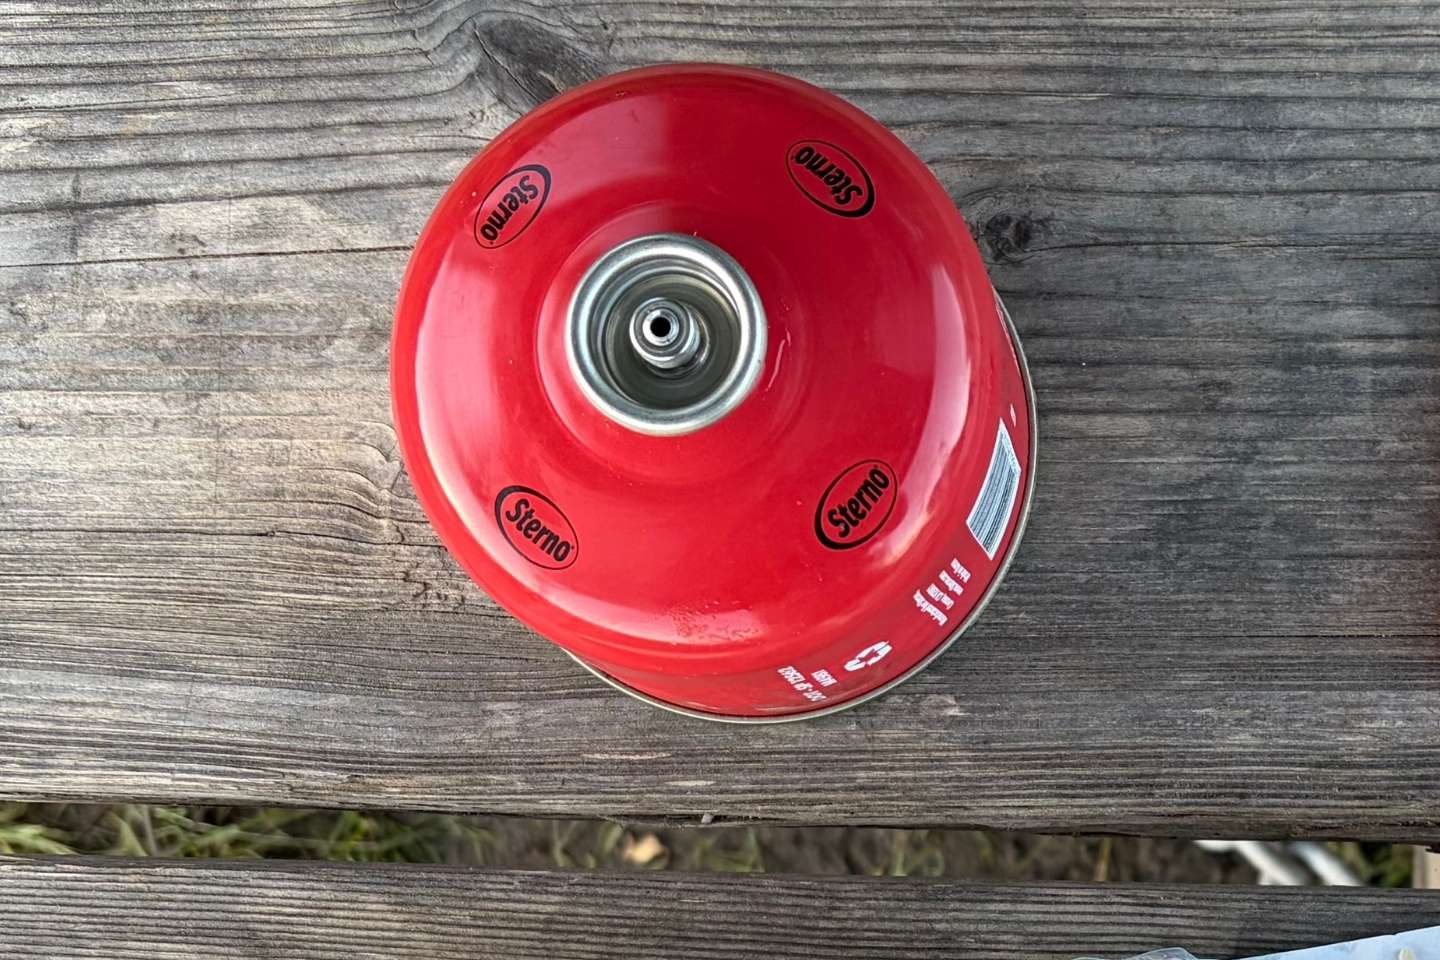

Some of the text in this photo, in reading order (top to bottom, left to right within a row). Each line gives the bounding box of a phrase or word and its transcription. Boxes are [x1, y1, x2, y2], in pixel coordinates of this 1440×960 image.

[480, 174, 539, 243] Sterno
[793, 145, 864, 206] Sterno
[505, 498, 572, 563] Sterno
[827, 465, 890, 538] Sterno
